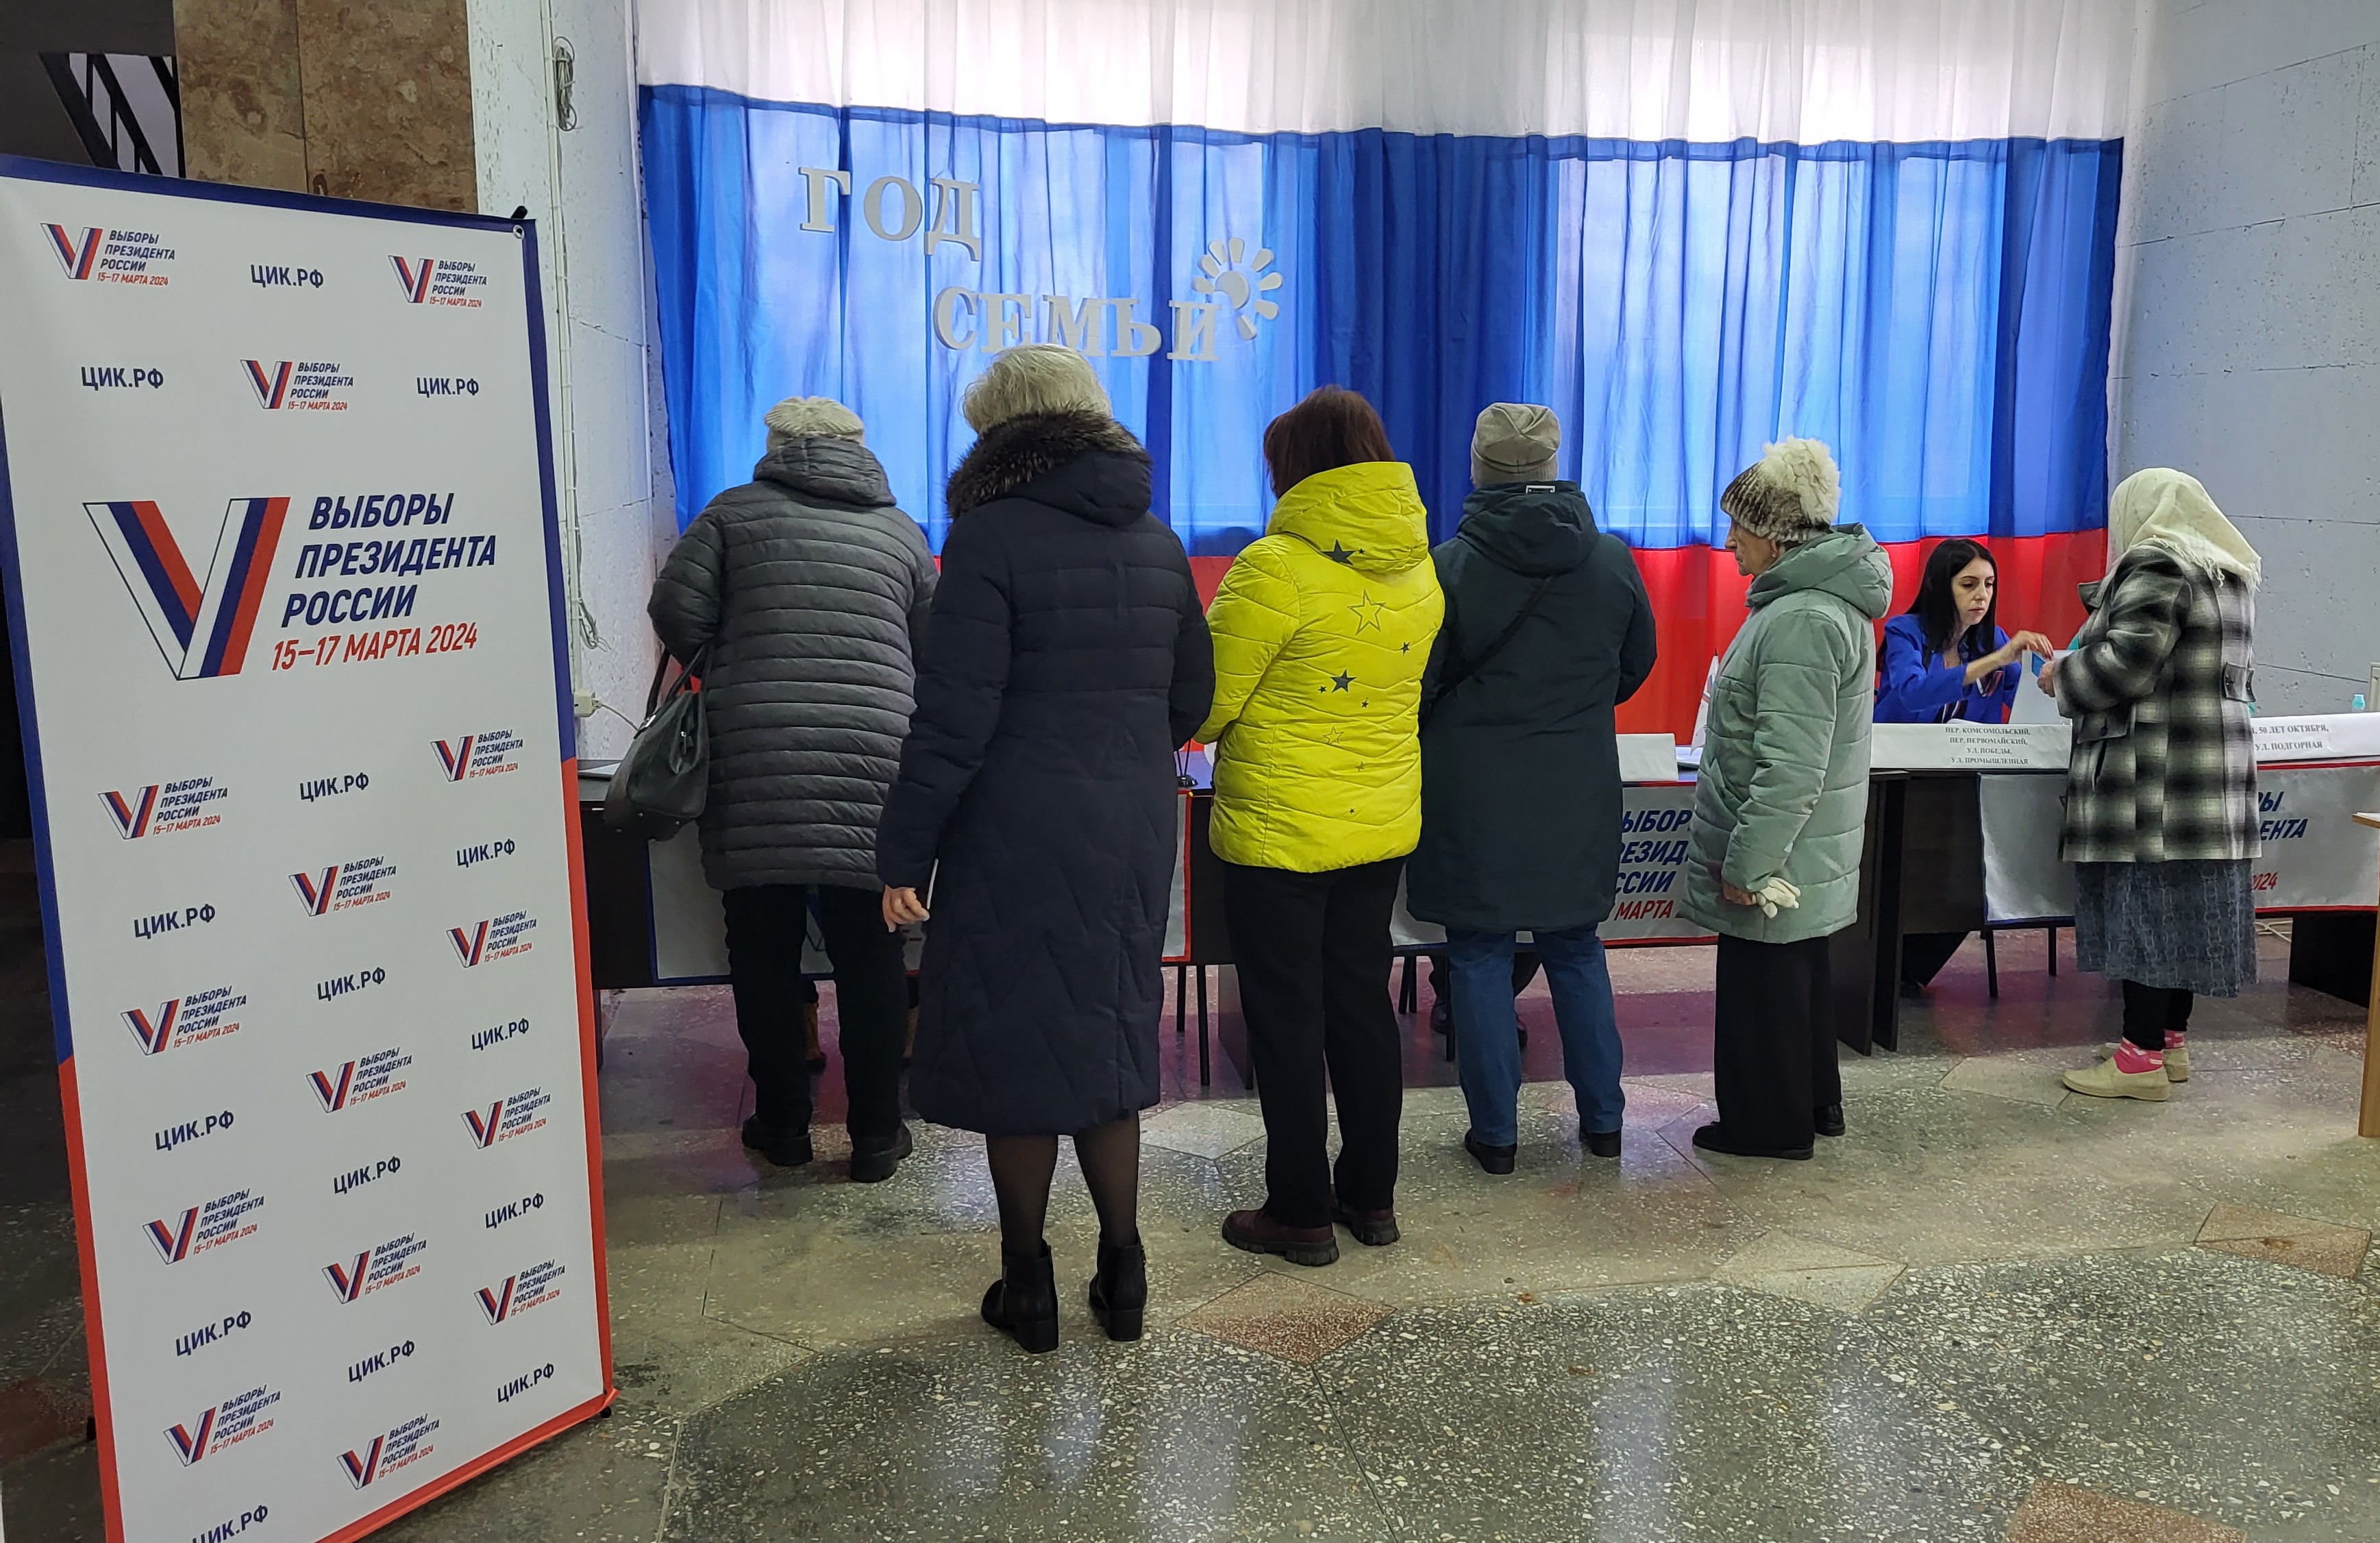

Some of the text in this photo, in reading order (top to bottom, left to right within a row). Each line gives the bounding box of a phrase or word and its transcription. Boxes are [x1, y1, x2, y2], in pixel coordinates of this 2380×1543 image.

[798, 166, 981, 262] ГОД
[109, 230, 159, 244] ВЫБОРЫ
[105, 244, 175, 260] ПРЕЗИДЕНТА
[100, 258, 146, 271] РОССИИ
[438, 260, 475, 272] ВЫБОРЫ
[121, 274, 147, 284] МАРТА
[149, 276, 168, 285] 2024
[251, 264, 323, 288] ЦИК.РФ
[435, 273, 486, 285] ПРЕЗИДЕНТА
[432, 285, 466, 296] РОССИИ
[933, 286, 1222, 361] СЕМЬИ
[298, 362, 340, 373] ВЫБОРЫ
[82, 367, 163, 391] ЦИК.РФ
[294, 375, 353, 387] ПРЕЗИДЕНТА
[417, 378, 479, 398] ЦИК.РФ
[290, 388, 329, 399] РОССИИ
[308, 402, 330, 410] МАРТА
[332, 402, 347, 410] 2024
[308, 493, 454, 530] ВЫБОРЫ
[295, 535, 495, 579] ПРЕЗИДЕНТА
[281, 584, 418, 628] РОССИИ
[343, 628, 421, 663] МАРТА
[425, 622, 477, 654] 2024
[478, 729, 512, 743] ВЫБОРЫ
[2271, 741, 2323, 750] ПОДГОРНАЯ
[475, 739, 523, 756] ПРЕЗИДЕНТА
[471, 754, 504, 768] РОССИИ
[164, 776, 213, 793] ВЫБОРЫ
[300, 772, 369, 802] ЦИК.РФ
[160, 788, 227, 808] ПРЕЗИДЕНТА
[156, 805, 199, 823] РОССИИ
[175, 818, 201, 831] МАРТА
[202, 815, 220, 826] 2024
[1622, 810, 1693, 832] ЫБОР
[2260, 819, 2309, 841] ЕНТА
[457, 839, 515, 868] ЦИК.РФ
[1621, 840, 1689, 865] ЕЗИД
[340, 865, 396, 887] ПРЕЗИДЕНТА
[343, 856, 384, 874] ВЫБОРЫ
[336, 882, 373, 900] РОССИИ
[351, 895, 374, 906] МАРТА
[375, 891, 390, 902] 2024
[134, 904, 215, 939] ЦИК.РФ
[493, 910, 526, 927] ВЫБОРЫ
[1613, 900, 1674, 921] МАРТА
[489, 919, 536, 939] ПРЕЗИДЕНТА
[486, 935, 518, 952] РОССИИ
[318, 967, 385, 1001] ЦИК.РФ
[185, 985, 232, 1007] ВЫБОРЫ
[181, 995, 246, 1022] ПРЕЗИДЕНТА
[177, 1015, 219, 1036] РОССИИ
[195, 1028, 221, 1042] МАРТА
[222, 1023, 239, 1035] 2024
[472, 1018, 529, 1050] ЦИК.РФ
[356, 1055, 412, 1081] ПРЕЗИДЕНТА
[360, 1047, 399, 1067] ВЫБОРЫ
[352, 1074, 389, 1094] РОССИИ
[368, 1086, 390, 1100] МАРТА
[391, 1081, 406, 1092] 2024
[504, 1094, 550, 1119] ПРЕЗИДЕНТА
[507, 1087, 541, 1107] ВЫБОРЫ
[156, 1111, 234, 1151] ЦИК.РФ
[501, 1112, 532, 1131] РОССИИ
[334, 1156, 400, 1194] ЦИК.РФ
[204, 1188, 250, 1213] ВЫБОРЫ
[486, 1193, 543, 1229] ЦИК.РФ
[201, 1196, 264, 1228] ПРЕЗИДЕНТА
[196, 1218, 238, 1242] РОССИИ
[214, 1231, 238, 1247] МАРТА
[240, 1224, 257, 1237] 2024
[371, 1239, 426, 1270] ПРЕЗИДЕНТА
[375, 1233, 414, 1257] ВЫБОРЫ
[367, 1261, 404, 1283] РОССИИ
[383, 1272, 404, 1287] МАРТА
[406, 1265, 420, 1278] 2024
[516, 1266, 565, 1294] ПРЕЗИДЕНТА
[519, 1259, 555, 1281] ВЫБОРЫ
[513, 1285, 545, 1306] РОССИИ
[176, 1311, 251, 1356] ЦИК.РФ
[349, 1340, 414, 1383] ЦИК.РФ
[497, 1363, 554, 1403] ЦИК.РФ
[217, 1391, 280, 1427] ПРЕЗИДЕНТА
[221, 1385, 266, 1413] ВЫБОРЫ
[213, 1415, 254, 1442] РОССИИ
[231, 1427, 256, 1445] МАРТА
[257, 1418, 273, 1433] 2024
[385, 1420, 439, 1454] ПРЕЗИДЕНТА
[388, 1414, 427, 1440] ВЫБОРЫ
[382, 1442, 417, 1467] РОССИИ
[397, 1453, 417, 1470] МАРТА
[419, 1444, 433, 1458] 2024
